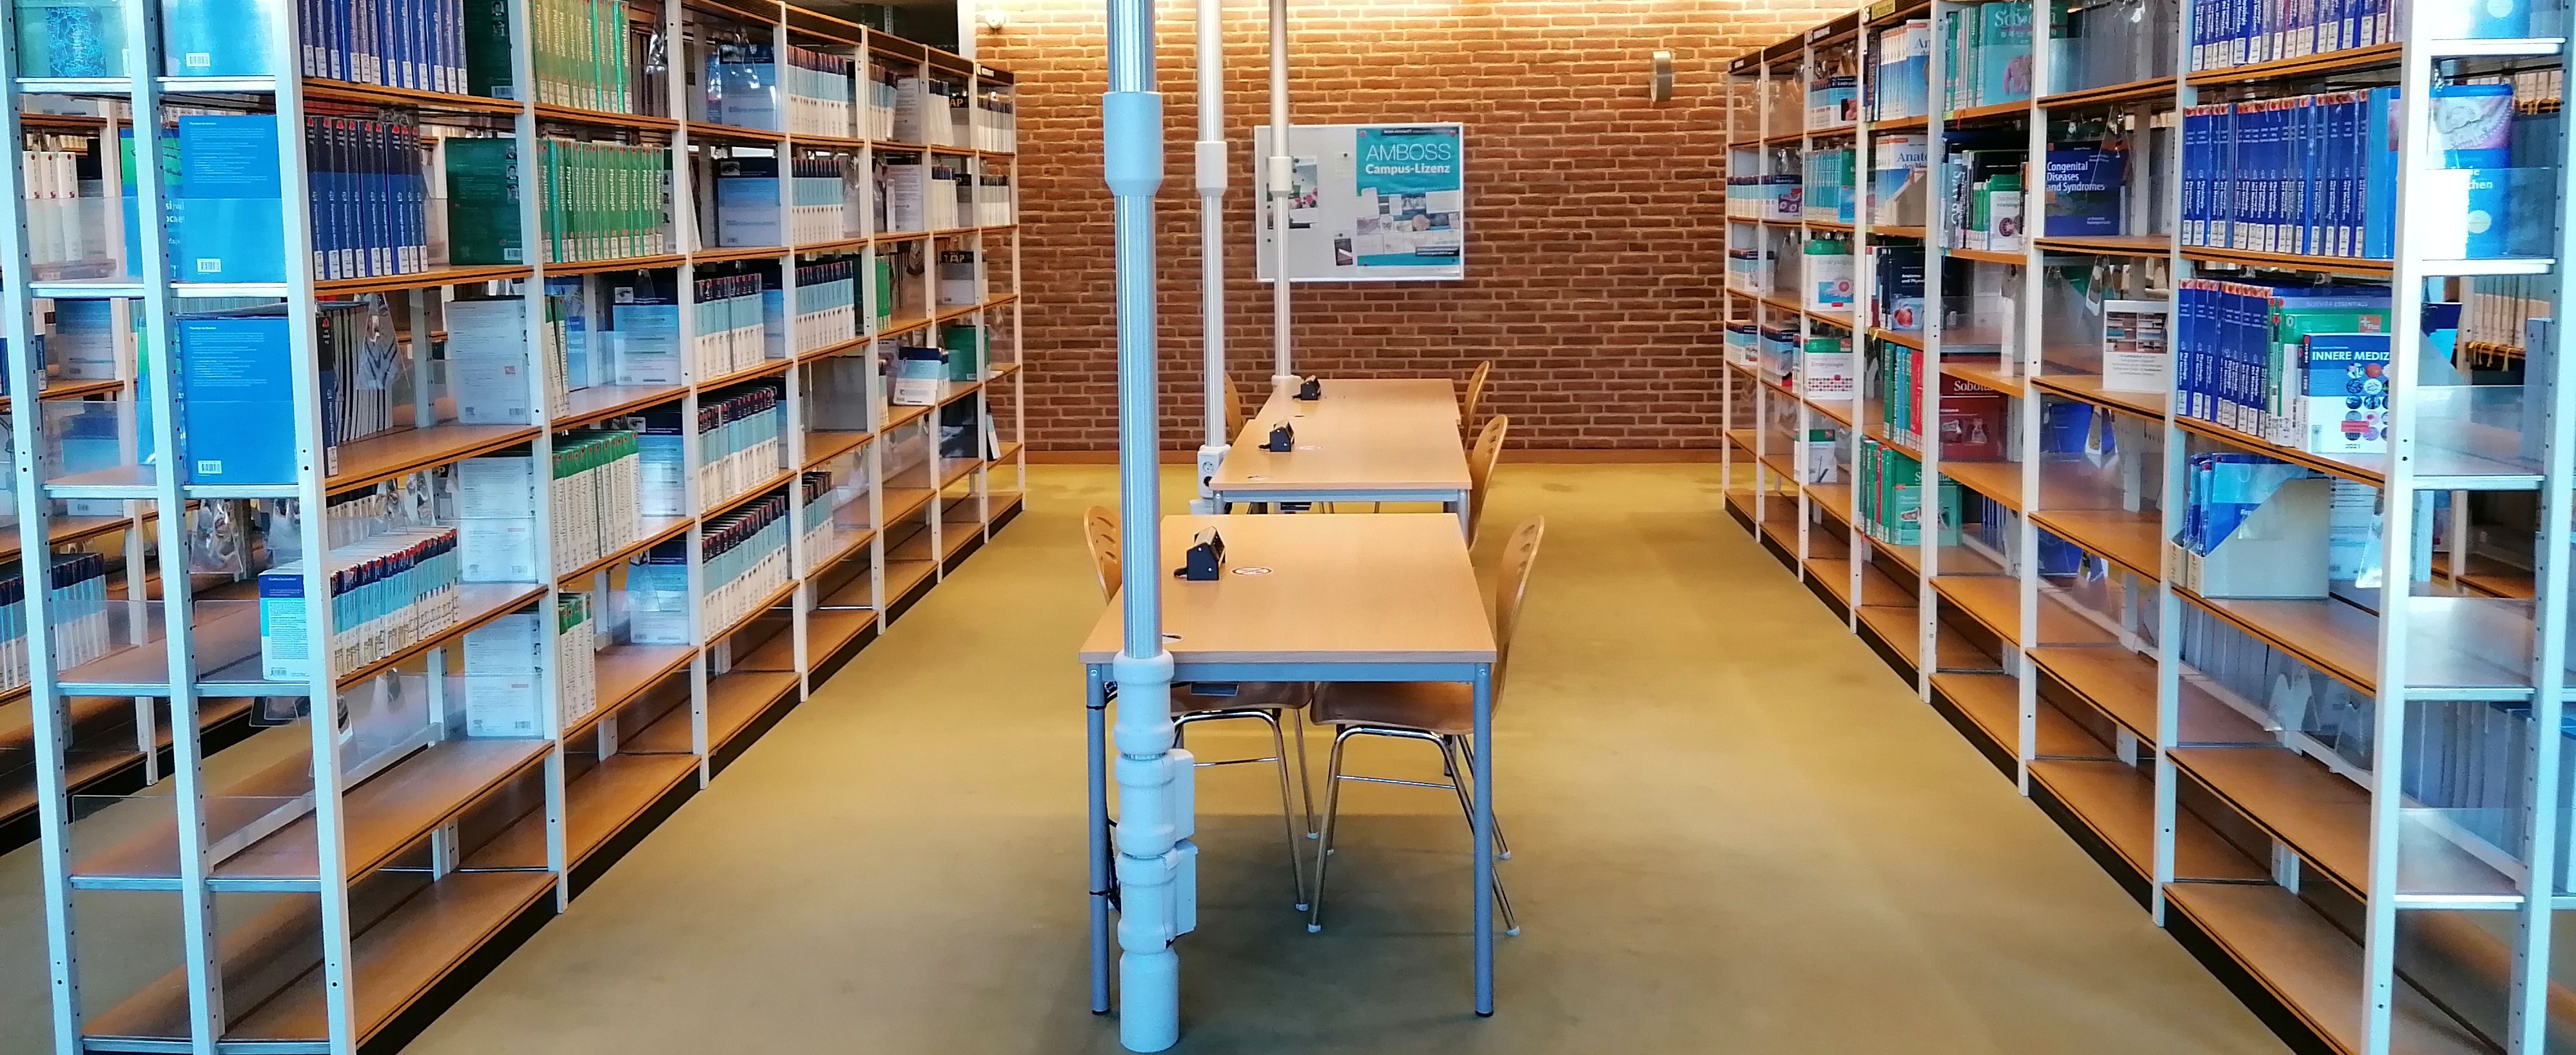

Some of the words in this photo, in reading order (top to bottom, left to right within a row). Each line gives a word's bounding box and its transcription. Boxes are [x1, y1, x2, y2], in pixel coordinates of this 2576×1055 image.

[1366, 144, 1450, 161] AMBOSS
[1365, 163, 1450, 175] Campus-Lizenz
[2047, 161, 2088, 173] Congenital
[2047, 173, 2080, 181] Diseases
[2047, 183, 2062, 192] and
[2063, 182, 2105, 193] Syndromes
[2312, 351, 2352, 360] INNERE
[2354, 351, 2390, 360] MEDIZ
